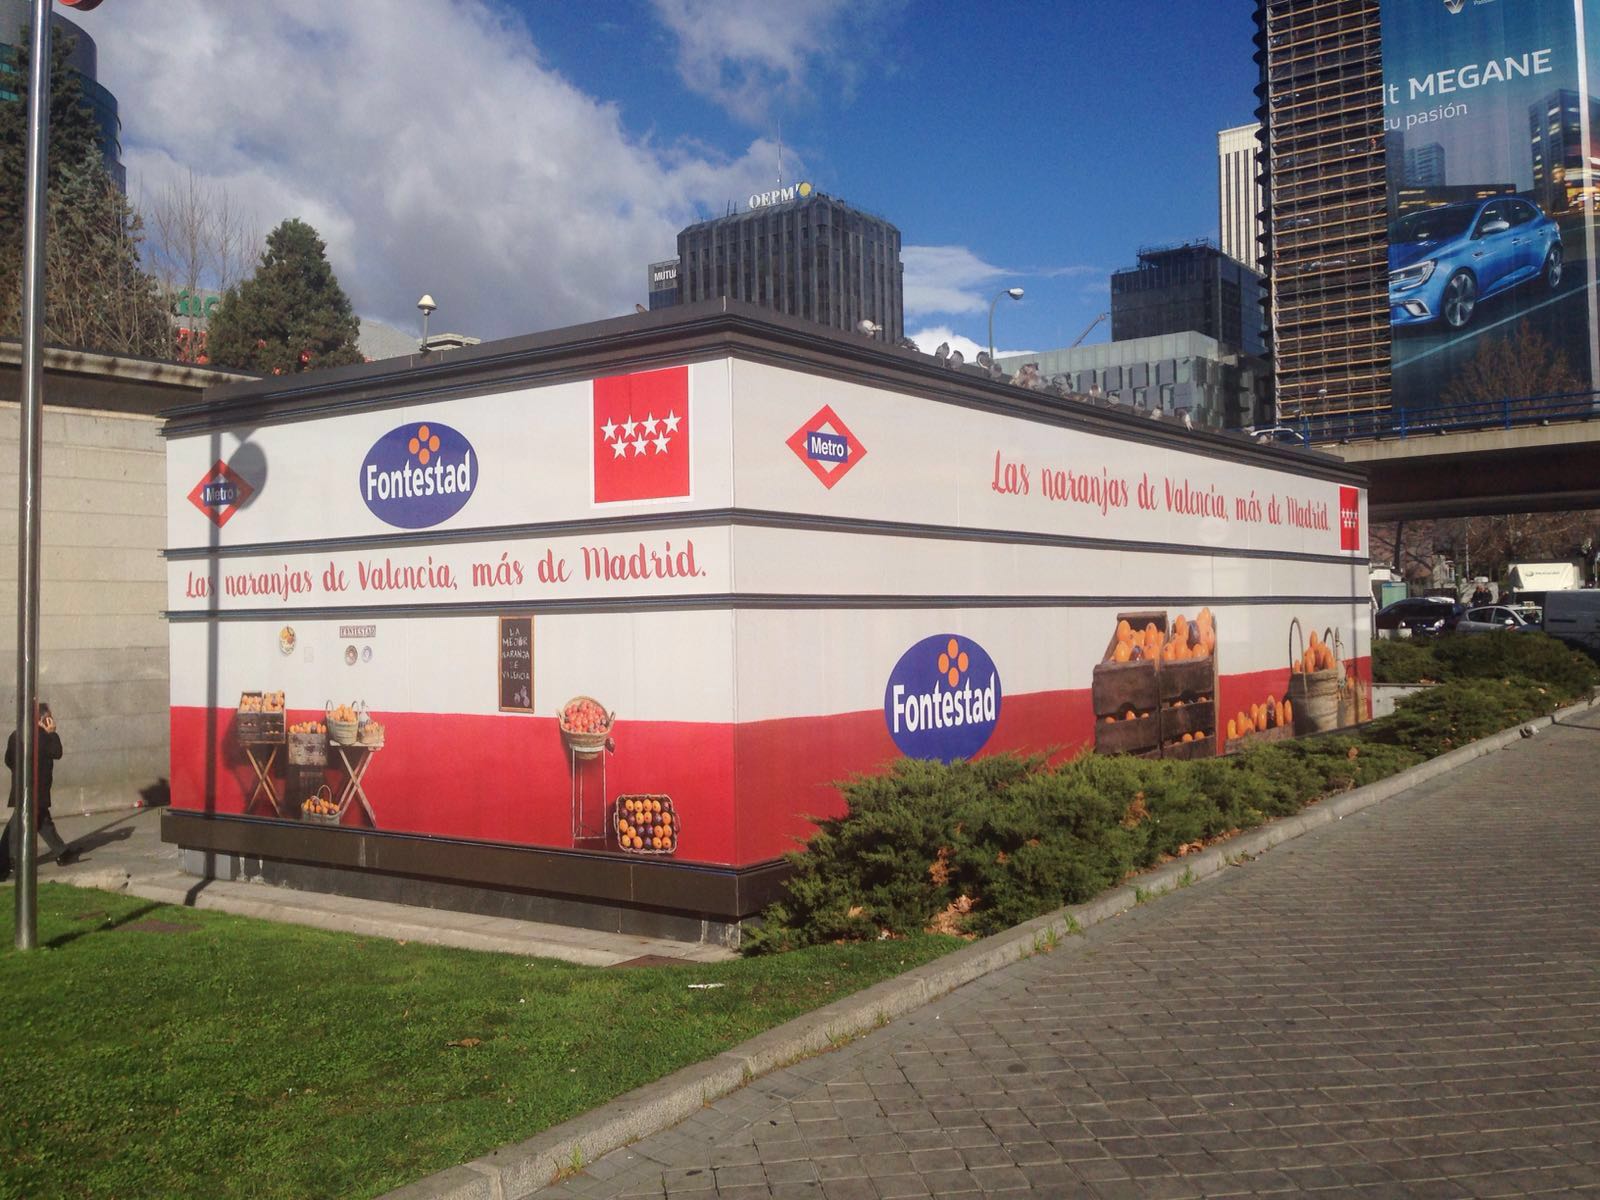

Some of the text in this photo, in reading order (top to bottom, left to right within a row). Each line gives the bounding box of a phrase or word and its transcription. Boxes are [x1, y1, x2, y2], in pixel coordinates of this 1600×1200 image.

[1408, 48, 1552, 100] MEGANE
[1406, 102, 1467, 130] pasión
[749, 186, 794, 208] OEPM
[811, 436, 844, 457] Metro
[206, 486, 234, 501] Metro
[366, 449, 470, 500] Fontestad
[991, 449, 1331, 531] Las naranjas de Valencia, más de Madrid.
[186, 539, 706, 602] Las naranjas de Valencia, más de Madrid.
[893, 671, 996, 734] Fontestad
